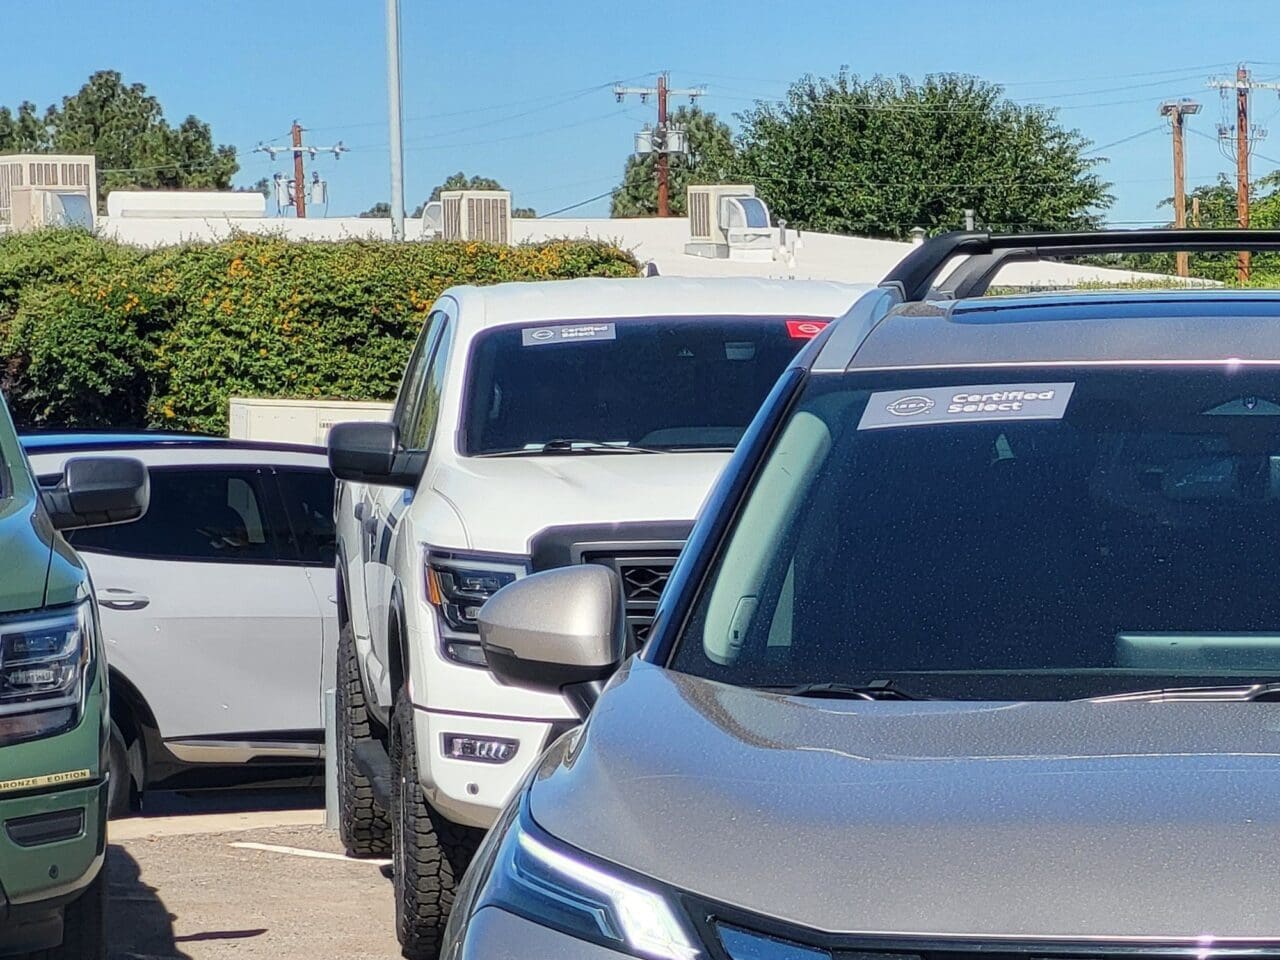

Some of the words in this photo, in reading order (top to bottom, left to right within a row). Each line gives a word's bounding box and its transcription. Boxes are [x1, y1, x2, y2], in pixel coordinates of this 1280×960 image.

[952, 390, 1056, 403] Certified
[947, 401, 1023, 414] Select
[47, 770, 87, 783] EDITION
